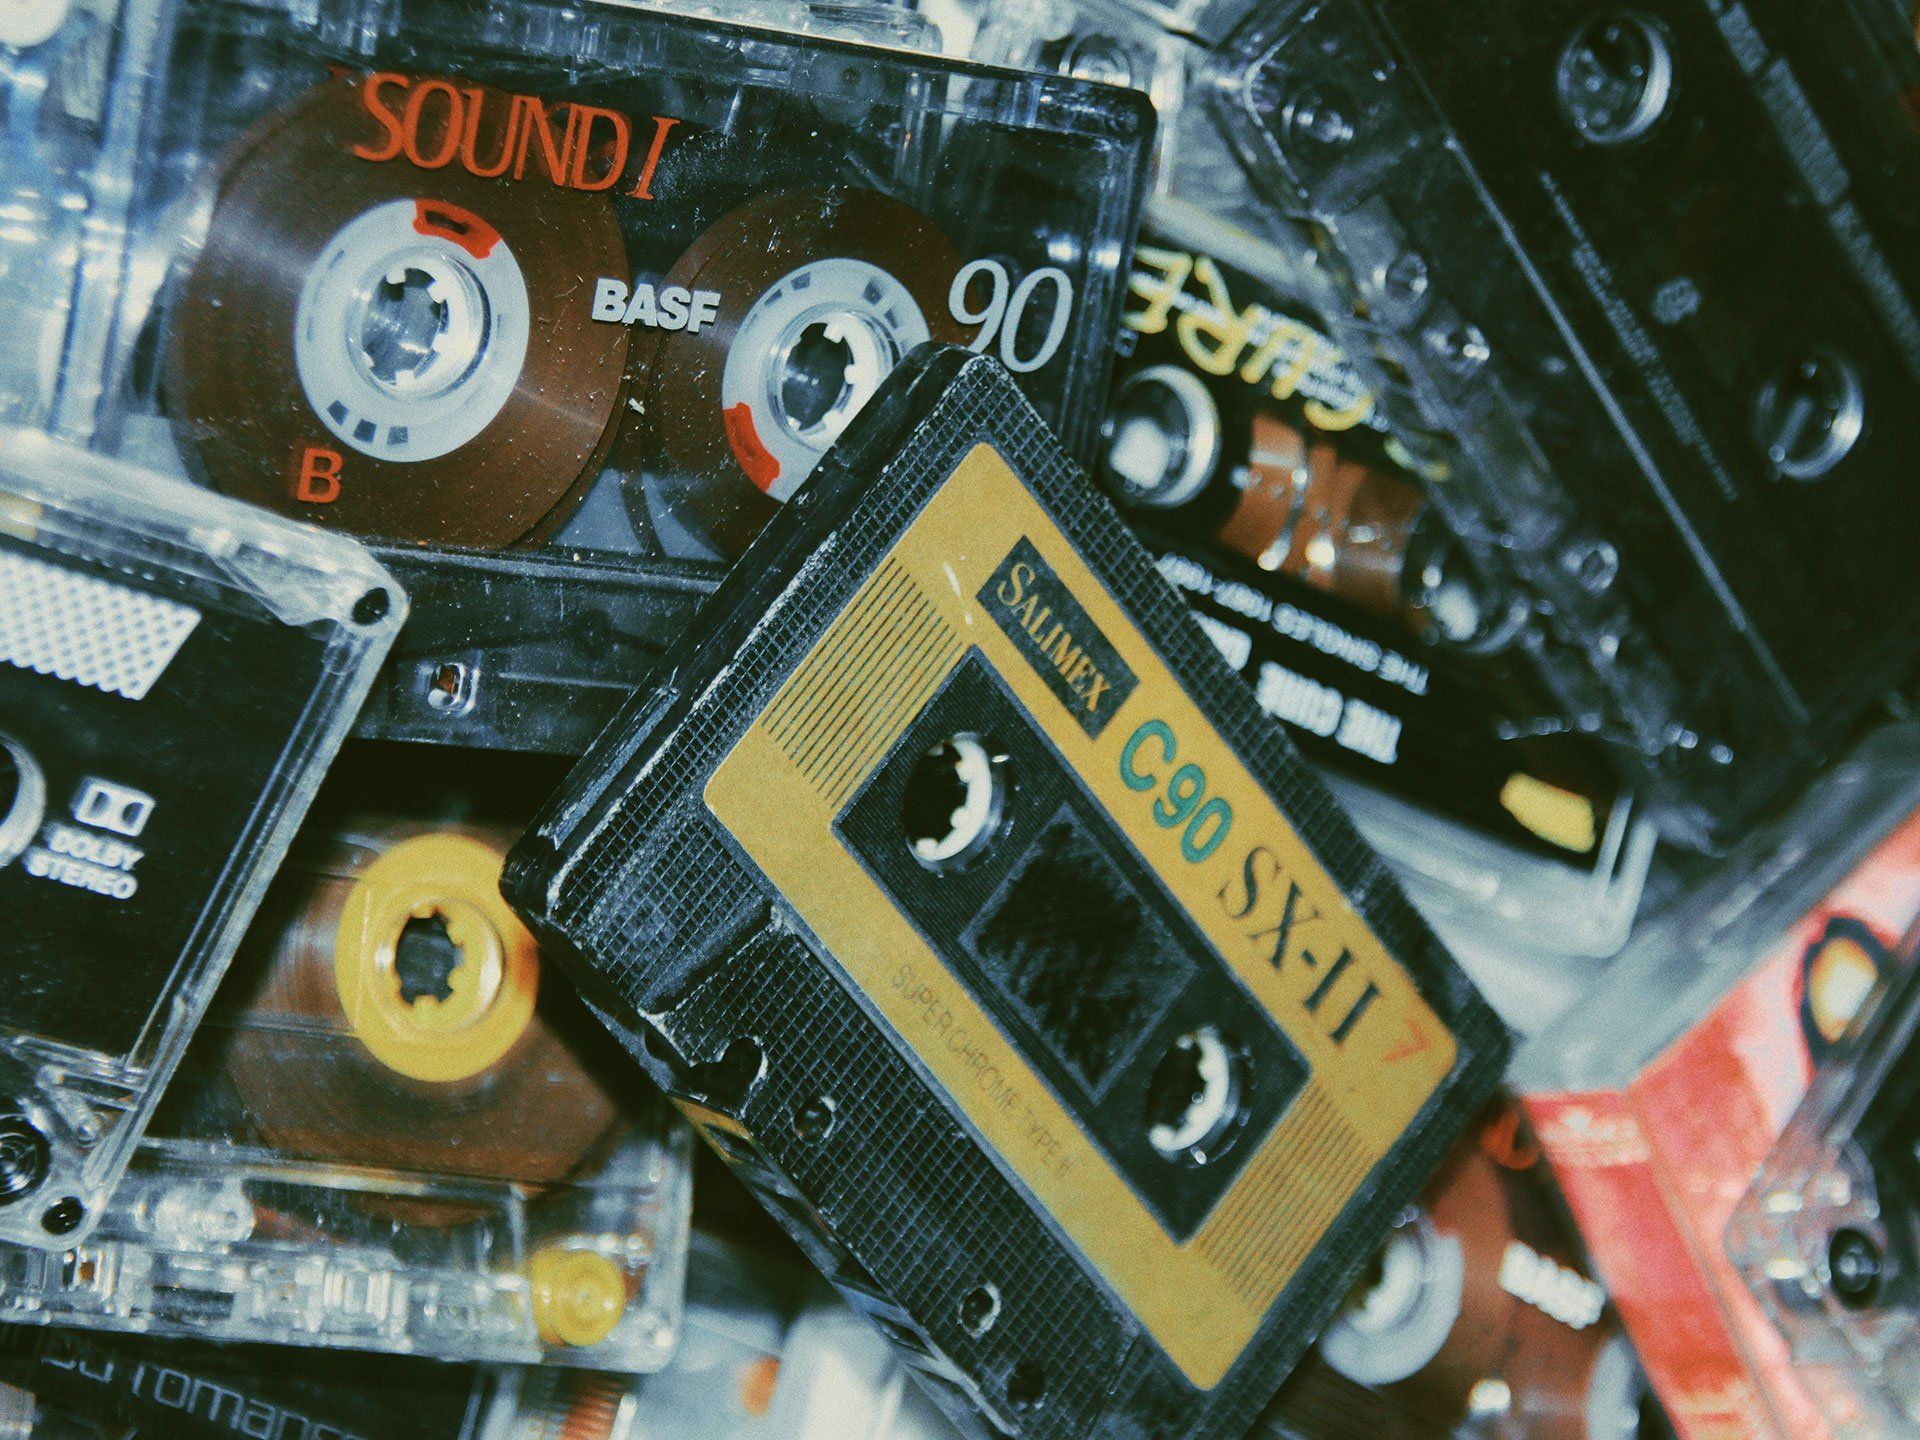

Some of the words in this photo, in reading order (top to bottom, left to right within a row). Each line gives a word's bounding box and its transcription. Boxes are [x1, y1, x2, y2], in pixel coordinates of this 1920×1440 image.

[352, 71, 631, 191] SOUND
[592, 277, 720, 333] BASF
[948, 258, 1074, 373] 90
[296, 447, 343, 505] B
[997, 562, 1112, 713] SALIMEX
[24, 846, 138, 900] STEREO
[47, 820, 145, 872] DOLBY
[1118, 719, 1233, 865] C90
[1217, 846, 1381, 1047] SX-II
[892, 963, 956, 1037] SUPER
[946, 1027, 1020, 1111] CHROME
